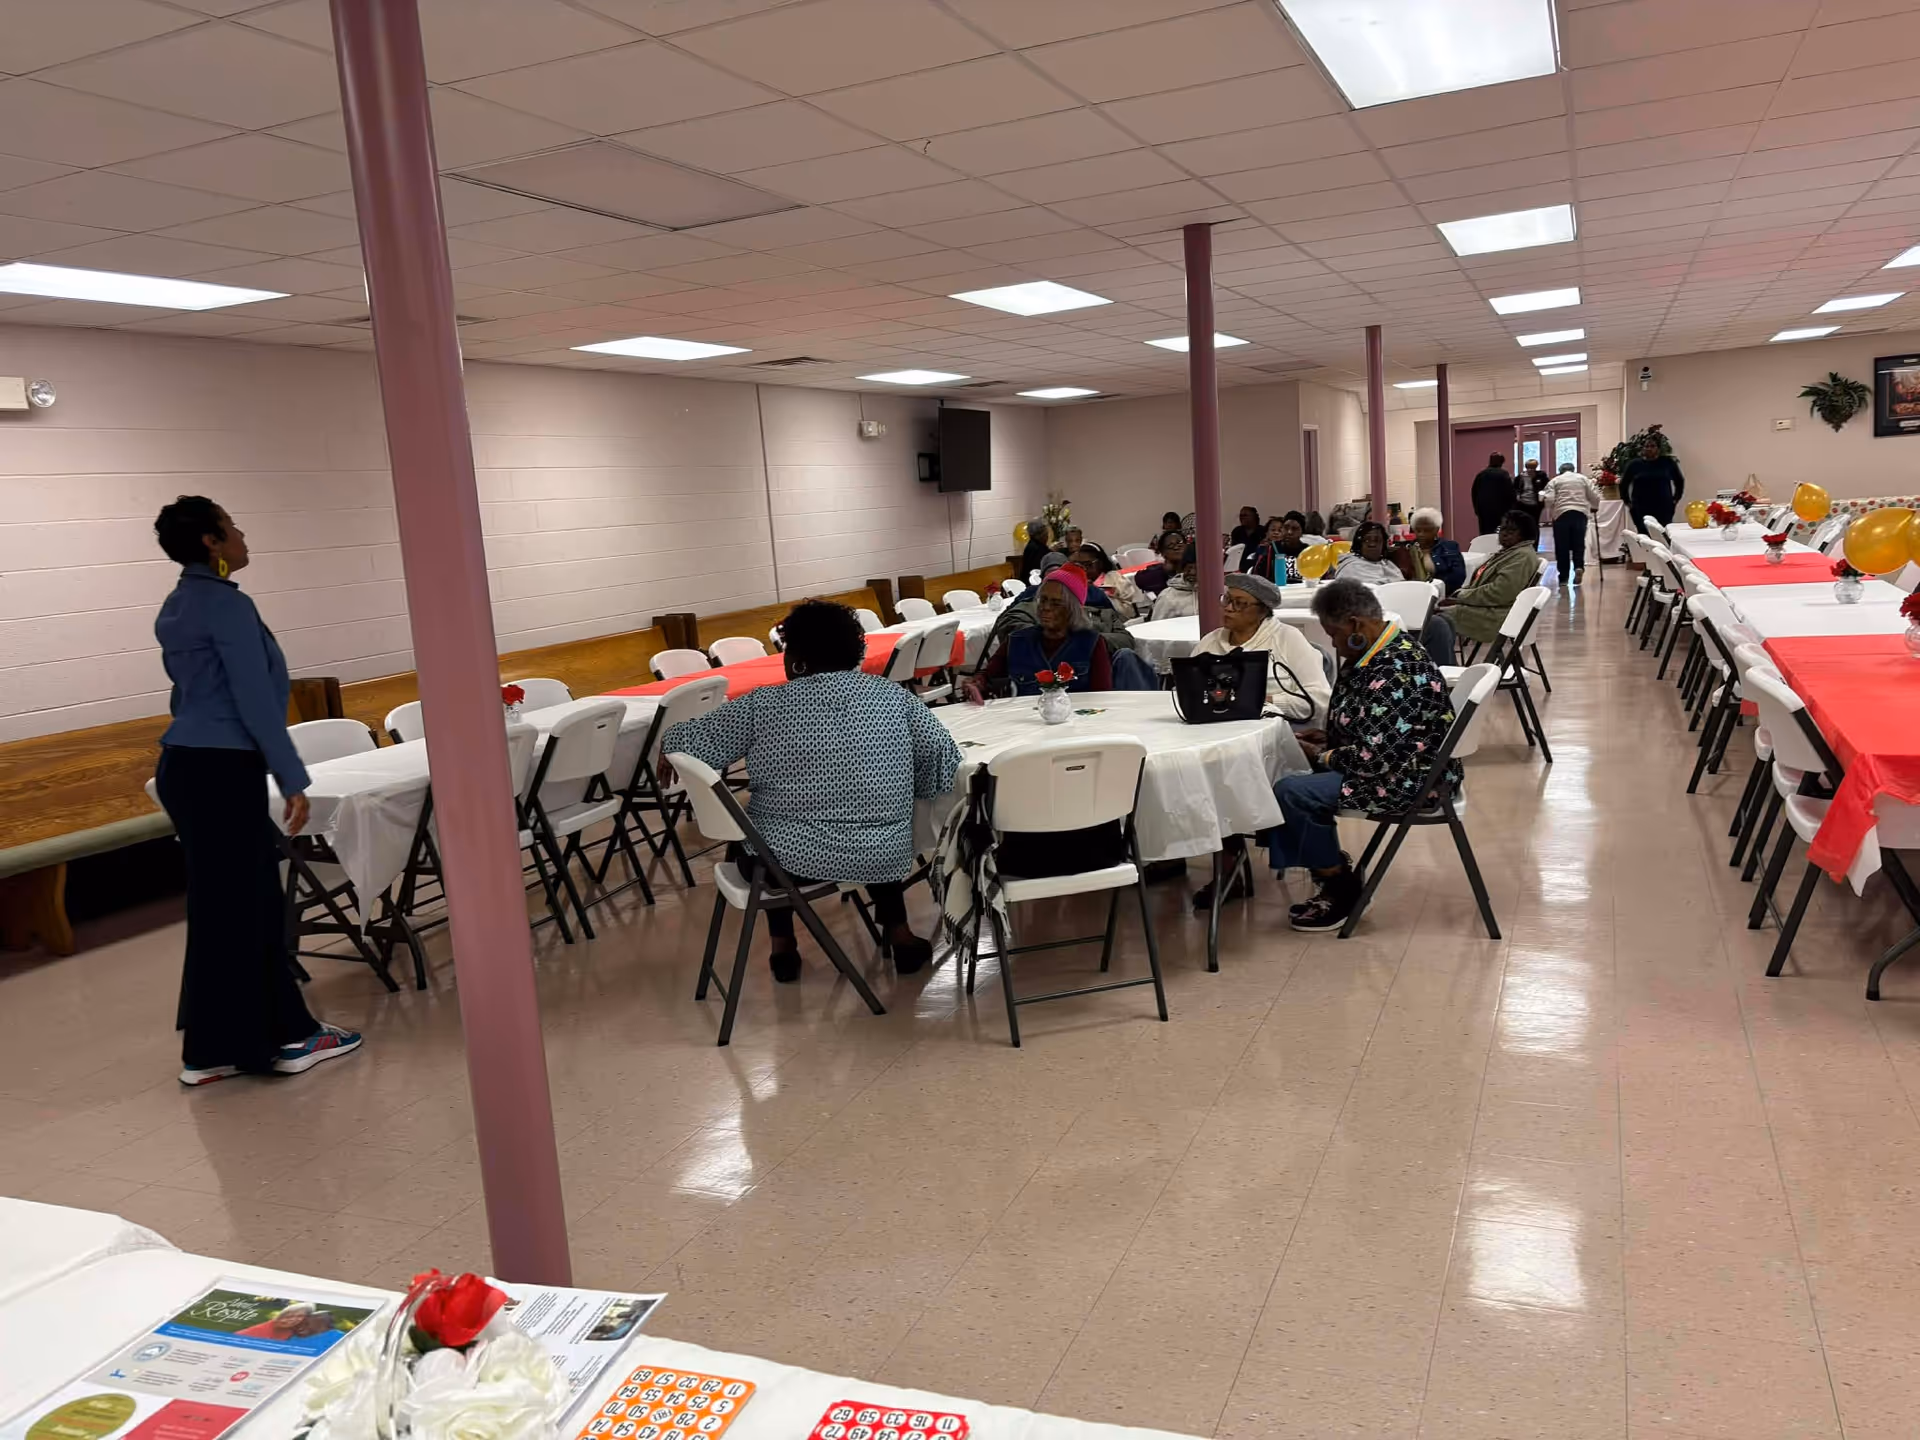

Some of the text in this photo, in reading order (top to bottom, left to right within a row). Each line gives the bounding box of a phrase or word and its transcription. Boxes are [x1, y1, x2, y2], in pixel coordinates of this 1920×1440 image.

[190, 1301, 259, 1322] Respite
[632, 1370, 742, 1396] 11 29 32 57 69
[619, 1386, 729, 1412] 5 25 34 55 64
[605, 1401, 717, 1430] 2 28 FREE 50 70
[833, 1408, 954, 1430] 11 16 33 59 62
[591, 1418, 610, 1432] 74
[613, 1422, 634, 1436] 54
[824, 1425, 842, 1439] 72
[638, 1426, 657, 1439] 43
[664, 1430, 681, 1440] 19
[850, 1428, 869, 1440] 49
[878, 1430, 896, 1440] 34
